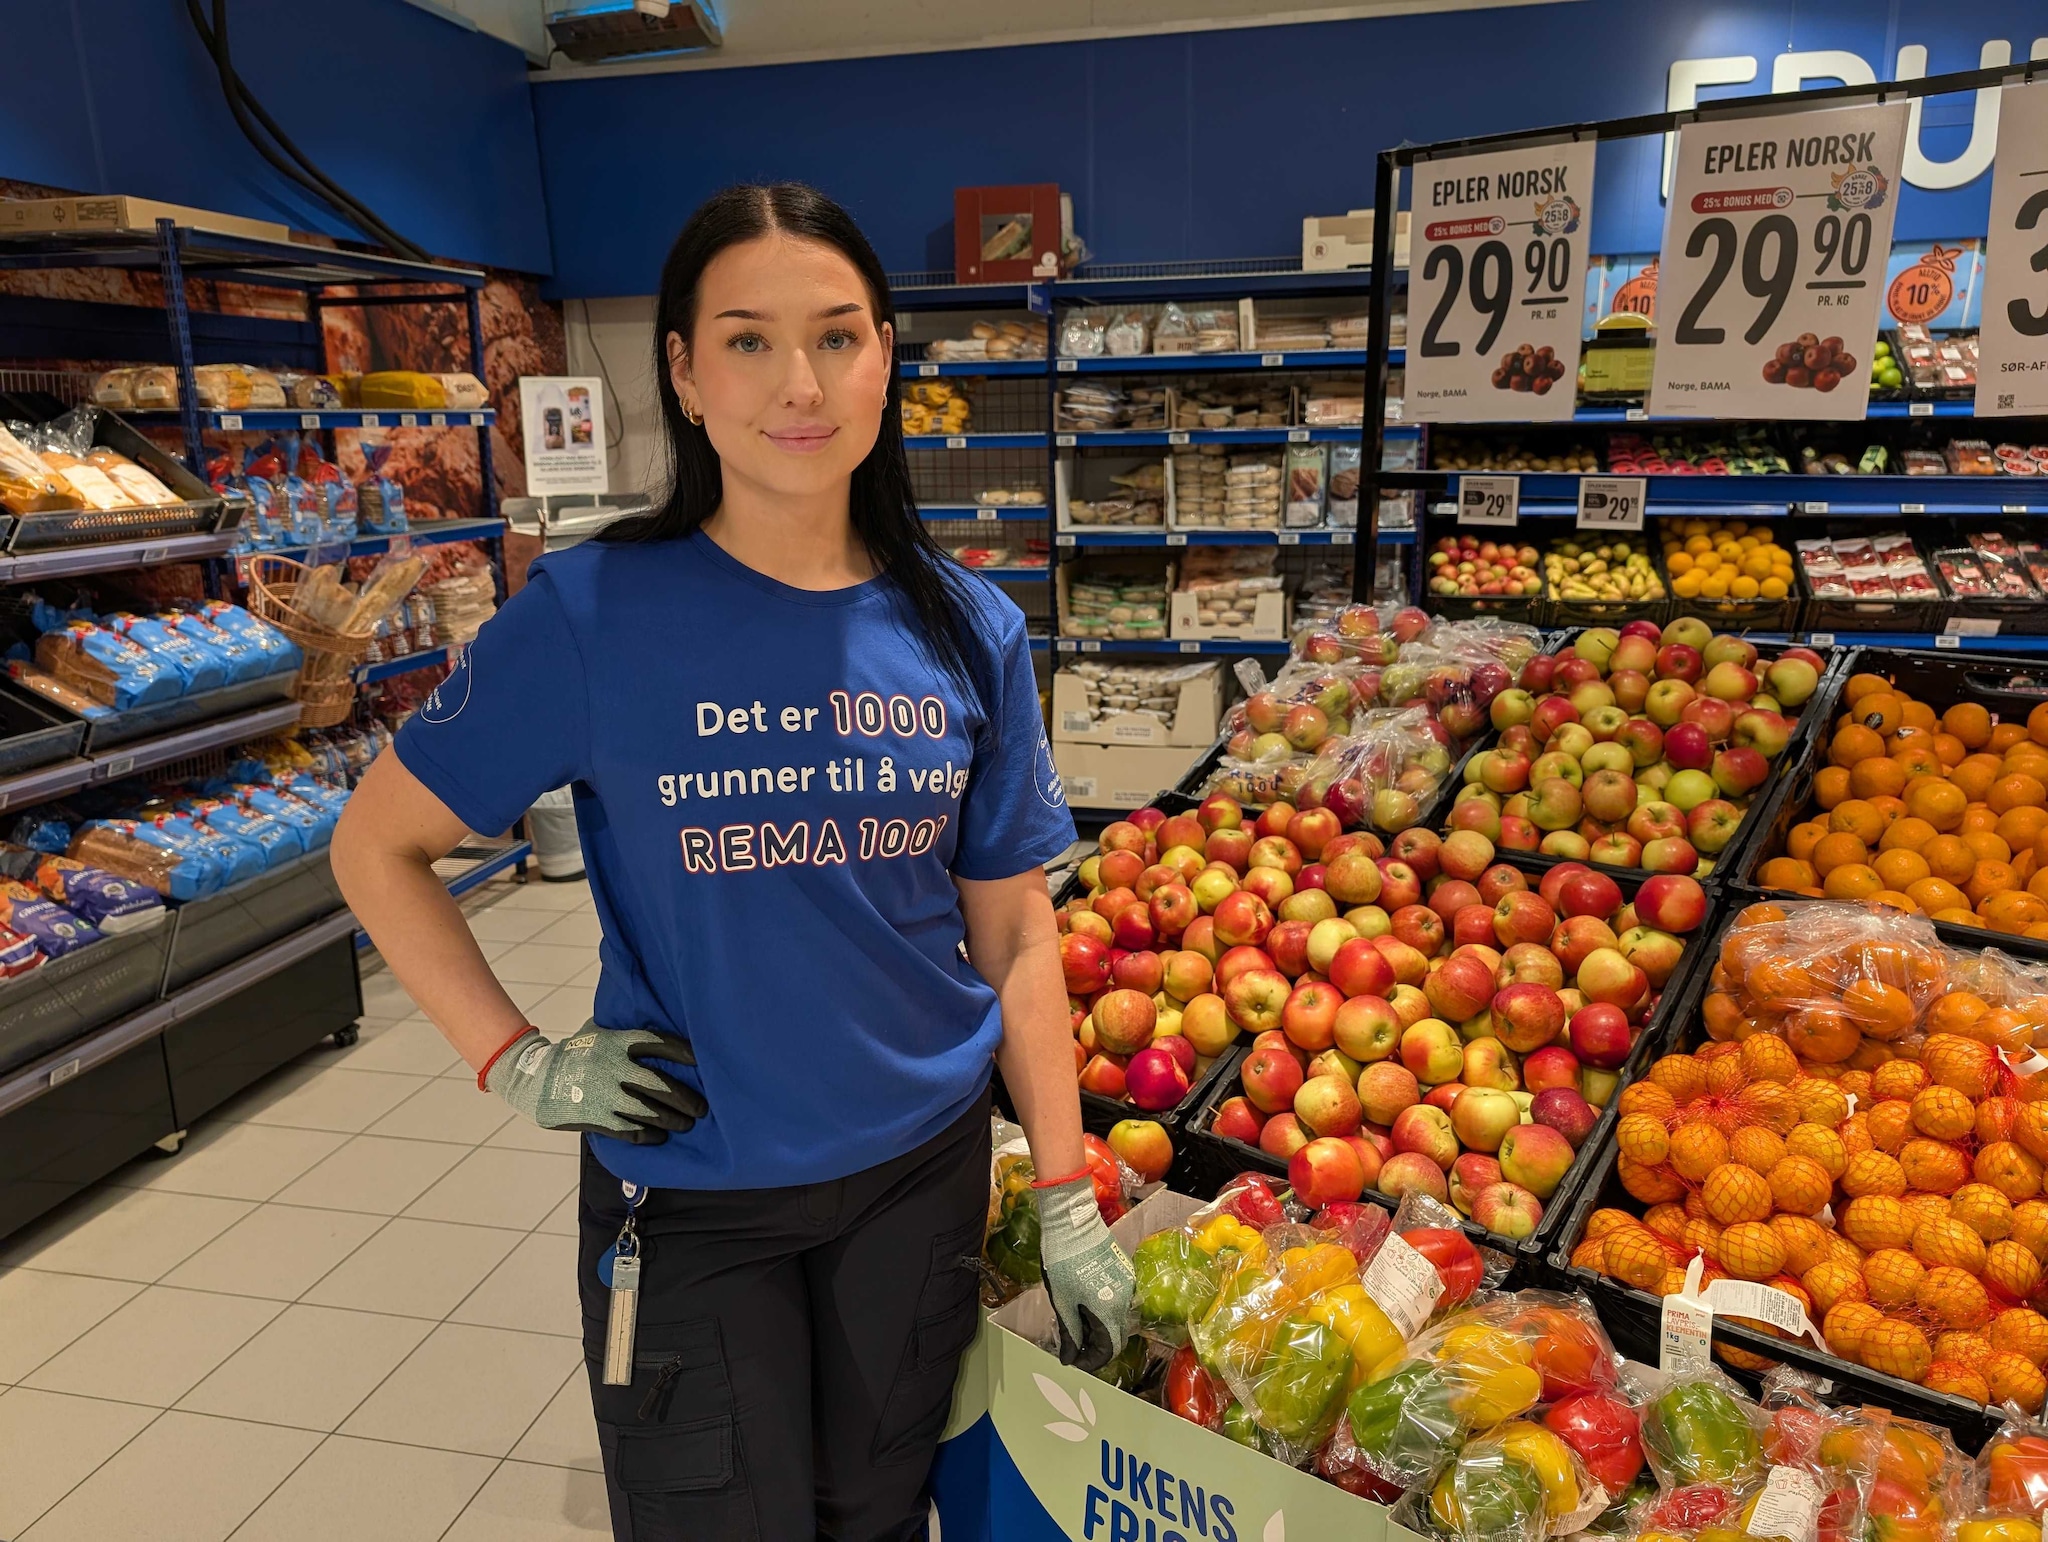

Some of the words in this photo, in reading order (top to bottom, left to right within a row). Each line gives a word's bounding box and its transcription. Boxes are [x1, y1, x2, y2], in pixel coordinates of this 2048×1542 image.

[1704, 141, 1778, 174] EPLER
[1786, 131, 1876, 168] NORSK
[1433, 176, 1489, 207] EPLER
[1497, 166, 1568, 200] NORSK
[1723, 196, 1752, 207] BONUS
[1754, 194, 1772, 205] MED
[1449, 223, 1472, 236] BONUS
[1473, 222, 1489, 234] MED
[1814, 212, 1872, 276] 90
[1525, 237, 1571, 293] 90
[1675, 214, 1799, 346] 29
[1420, 240, 1513, 358] 29
[1546, 309, 1557, 319] KG
[1817, 295, 1833, 306] PR.
[1837, 294, 1849, 305] KG
[2000, 360, 2048, 373] SØR-AF
[1417, 390, 1441, 399] Norge,
[1443, 389, 1467, 398] BAMA
[1668, 381, 1697, 391] Norge,
[1700, 381, 1731, 391] BAMA
[1486, 494, 1505, 516] 29
[1608, 497, 1629, 520] 29
[697, 701, 768, 736] Det
[780, 706, 819, 732] er
[829, 690, 946, 739] 1000
[657, 766, 815, 807] grunner
[826, 757, 864, 792] til
[878, 756, 897, 792] å
[680, 819, 847, 873] REMA
[1666, 1325, 1707, 1339] KLEMENTIN
[1101, 1439, 1237, 1542] UKENS
